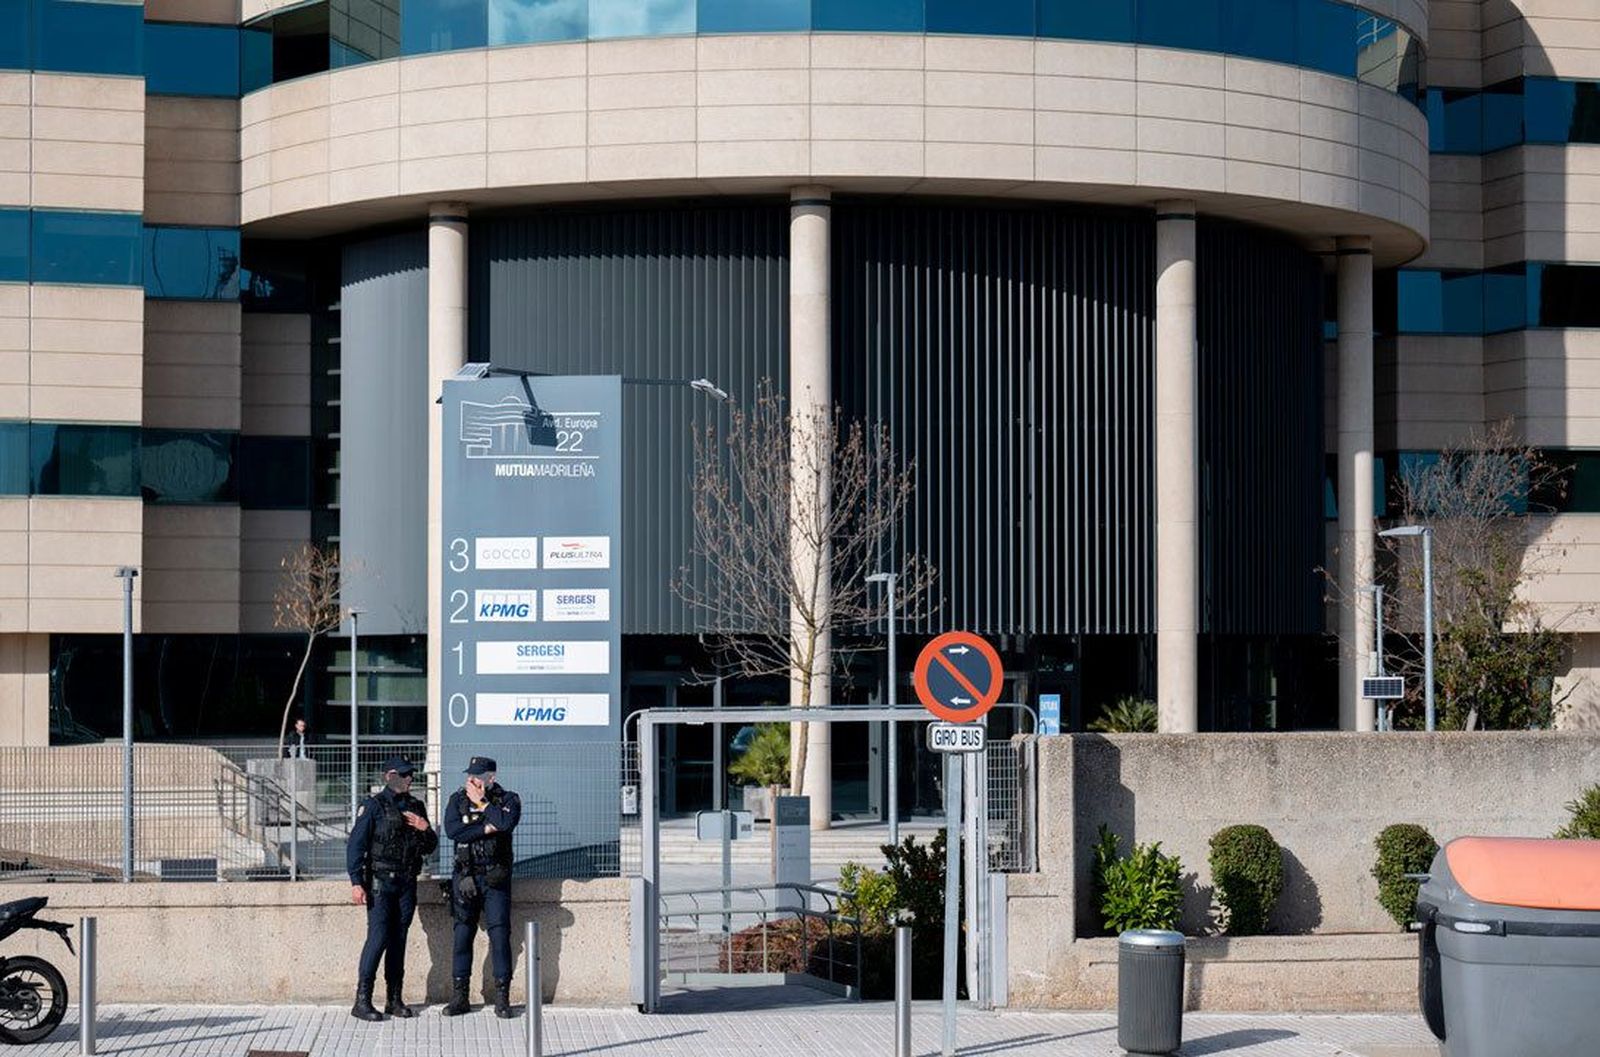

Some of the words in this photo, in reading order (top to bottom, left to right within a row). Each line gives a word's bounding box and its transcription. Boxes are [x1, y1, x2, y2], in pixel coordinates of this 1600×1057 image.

[564, 417, 598, 430] Europa
[555, 430, 583, 452] 22
[449, 537, 469, 572] 3
[482, 548, 531, 560] GOCCO
[449, 589, 469, 624] 2
[556, 594, 596, 605] SERGESI
[479, 603, 530, 618] KPMG
[452, 640, 464, 676] 1
[516, 644, 565, 657] SERGESI
[448, 692, 469, 728] 0
[513, 707, 567, 721] KPMG
[934, 729, 957, 746] GIRO
[961, 729, 981, 746] BUS
